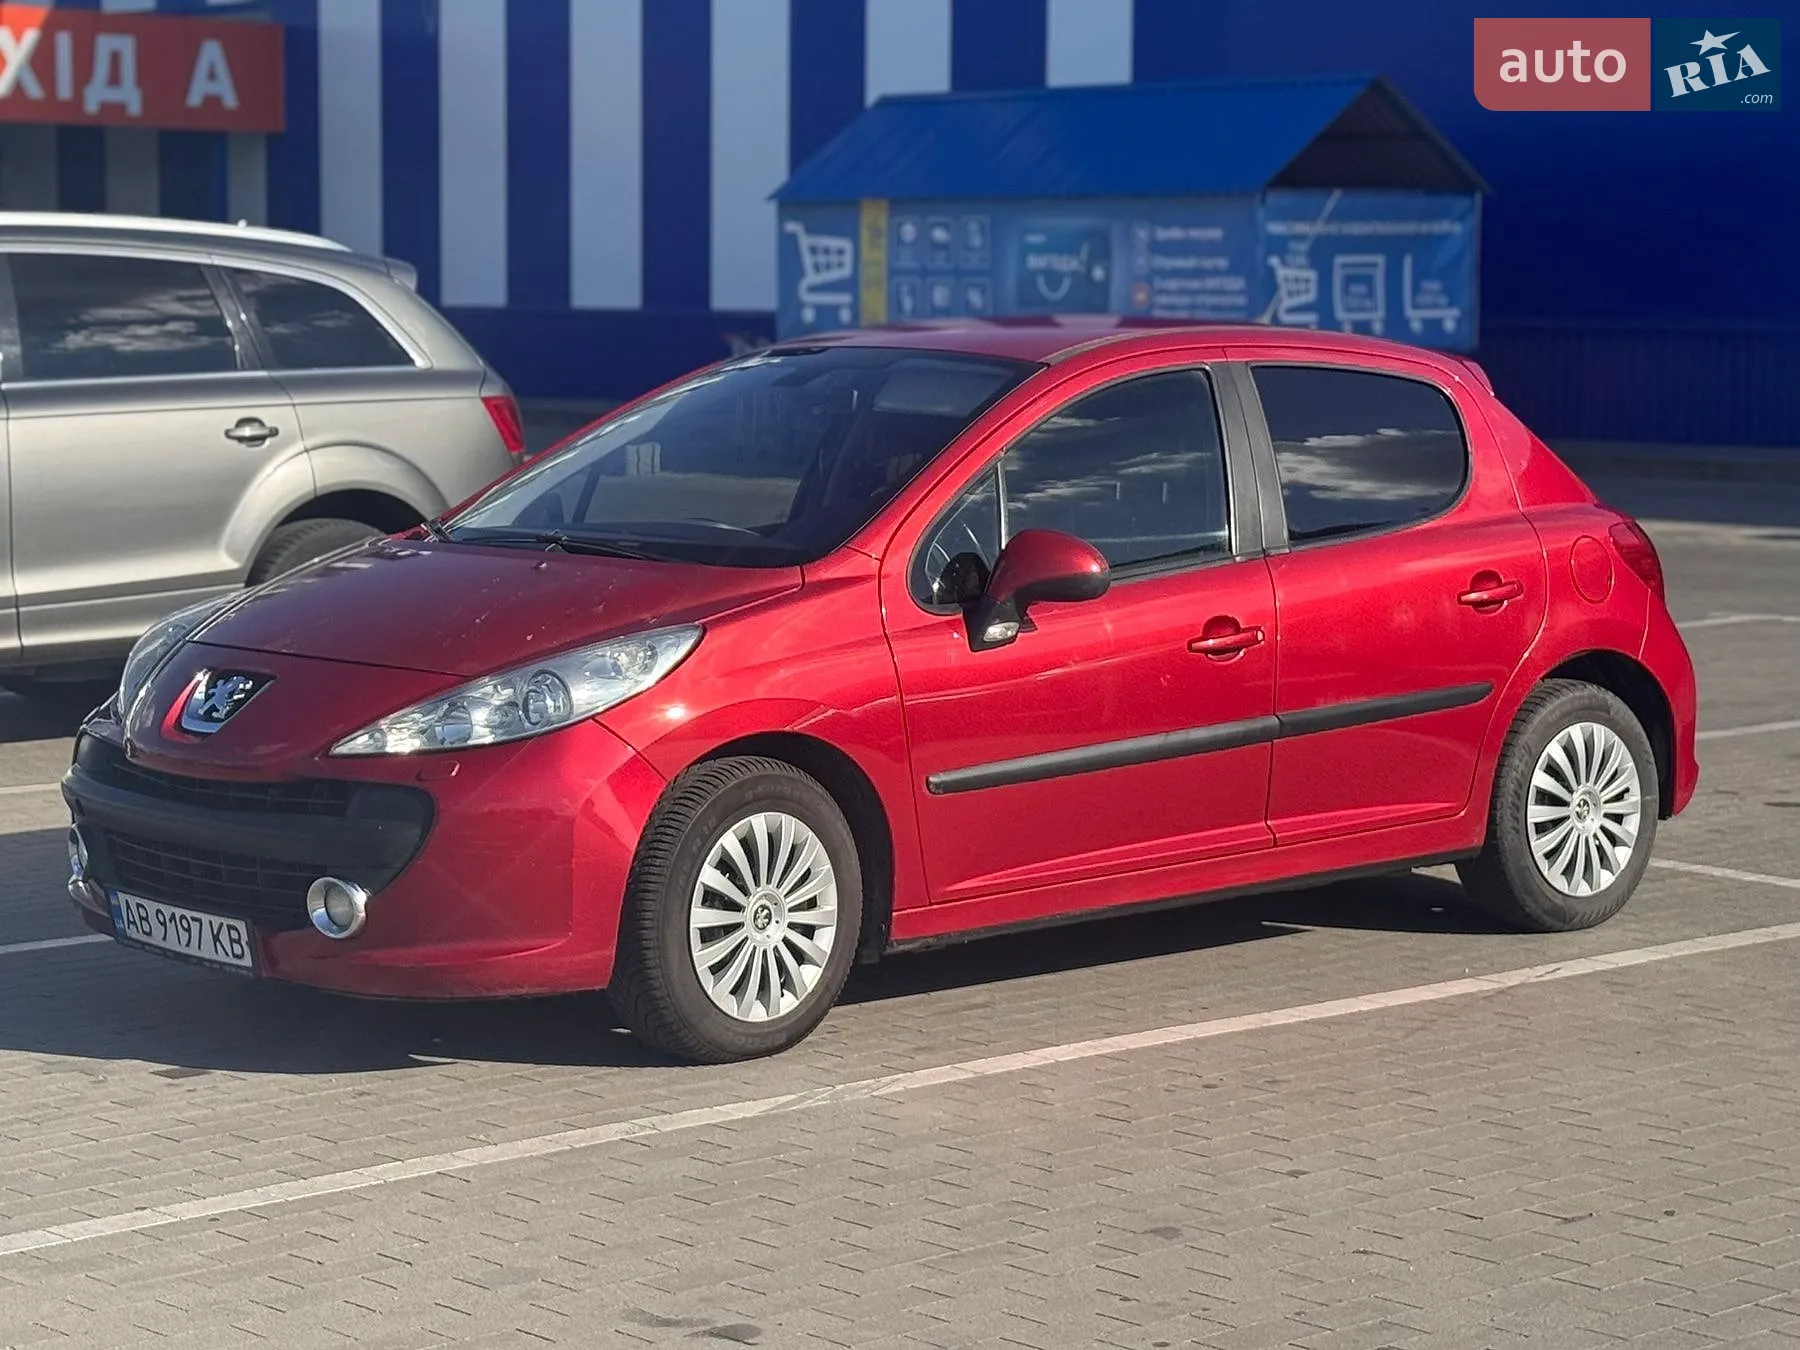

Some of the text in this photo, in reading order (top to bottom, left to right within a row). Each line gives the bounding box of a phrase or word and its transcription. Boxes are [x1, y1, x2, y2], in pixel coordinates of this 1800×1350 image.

[0, 26, 239, 117] ХІД А
[124, 899, 245, 960] AB 9197 KB
